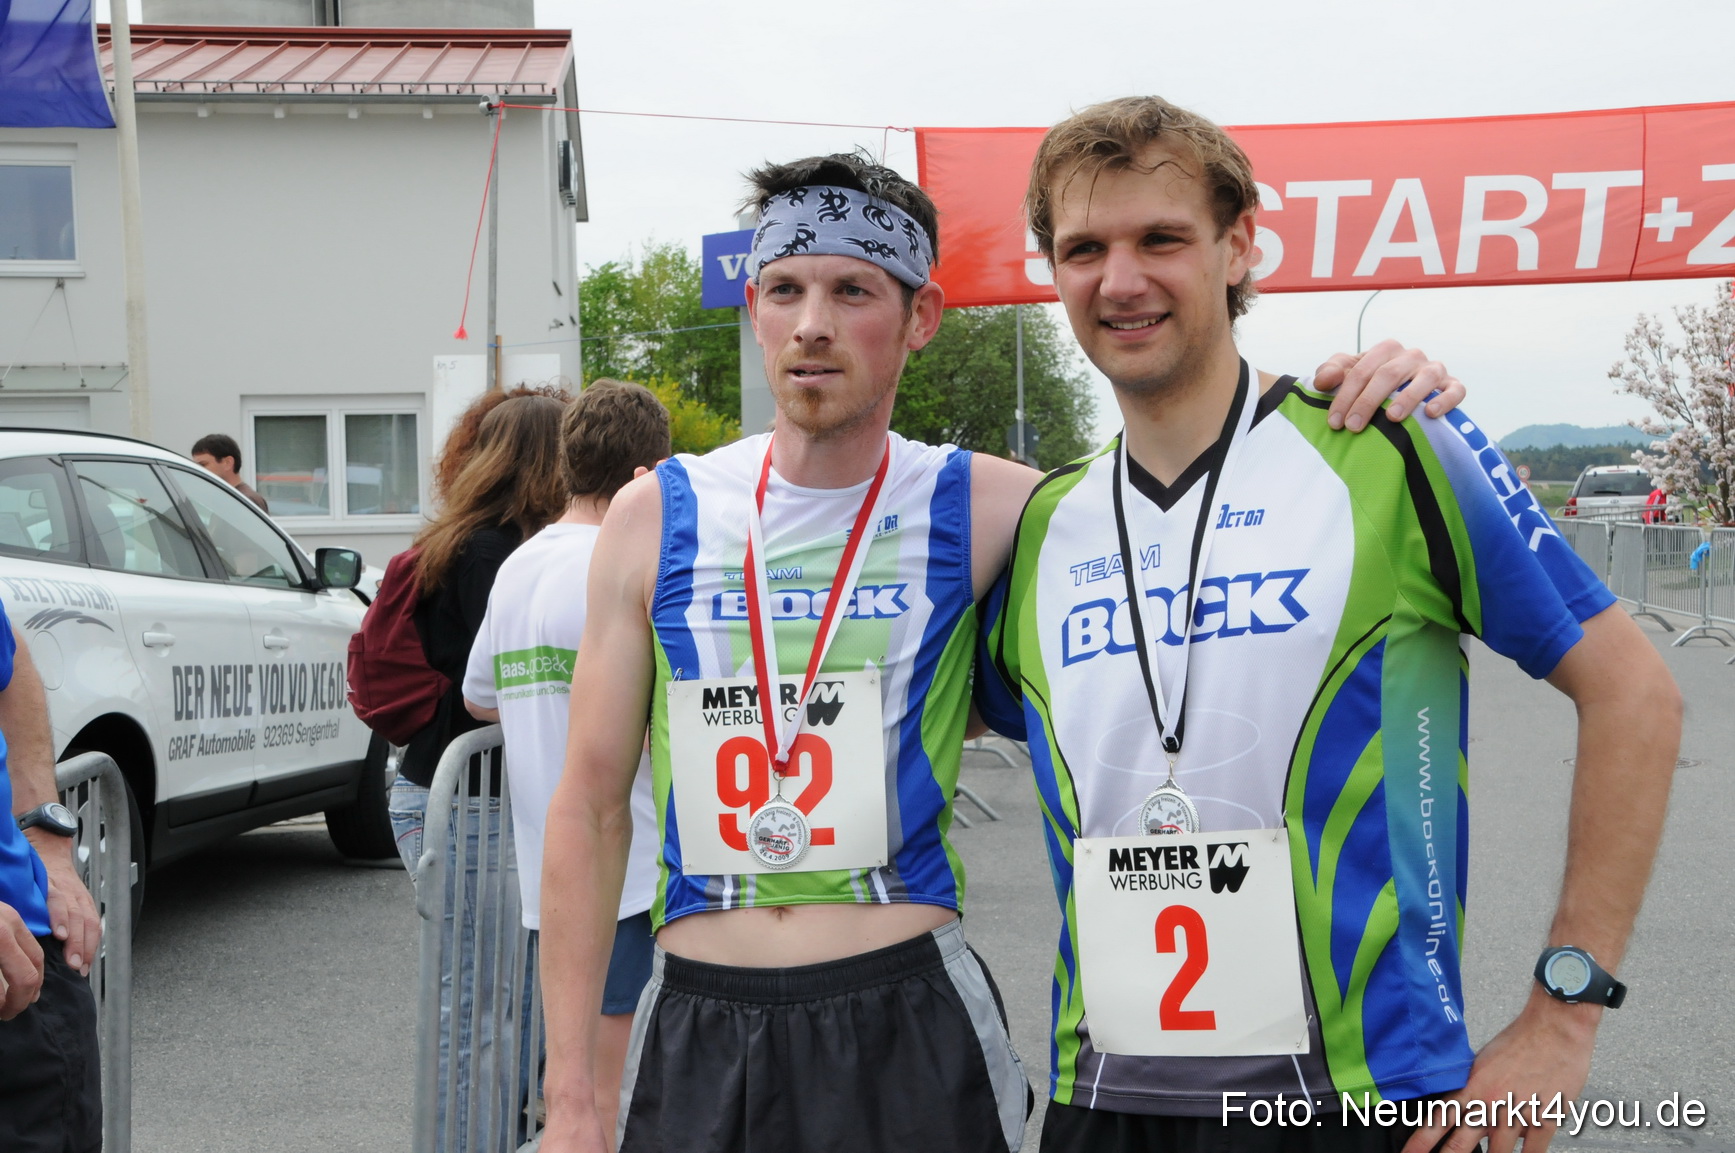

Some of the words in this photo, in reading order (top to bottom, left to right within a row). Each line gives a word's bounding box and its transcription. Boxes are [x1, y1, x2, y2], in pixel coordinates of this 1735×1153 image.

[43, 579, 114, 611] TESTEN!
[712, 582, 910, 620] BOCK
[1062, 568, 1312, 668] BOCK
[172, 665, 205, 721] DER
[210, 664, 253, 719] NEUE
[258, 663, 307, 715] VOLVO
[702, 681, 798, 710] MEYR
[168, 734, 196, 762] GRAF
[196, 728, 256, 757] Automobile
[263, 723, 295, 749] 92369
[295, 718, 340, 747] Sengenthal
[716, 733, 835, 852] 92
[1108, 845, 1201, 872] MEYER
[1416, 706, 1458, 1024] www.bockonline.de
[1109, 871, 1203, 891] WERBUNG
[1154, 904, 1217, 1031] 2
